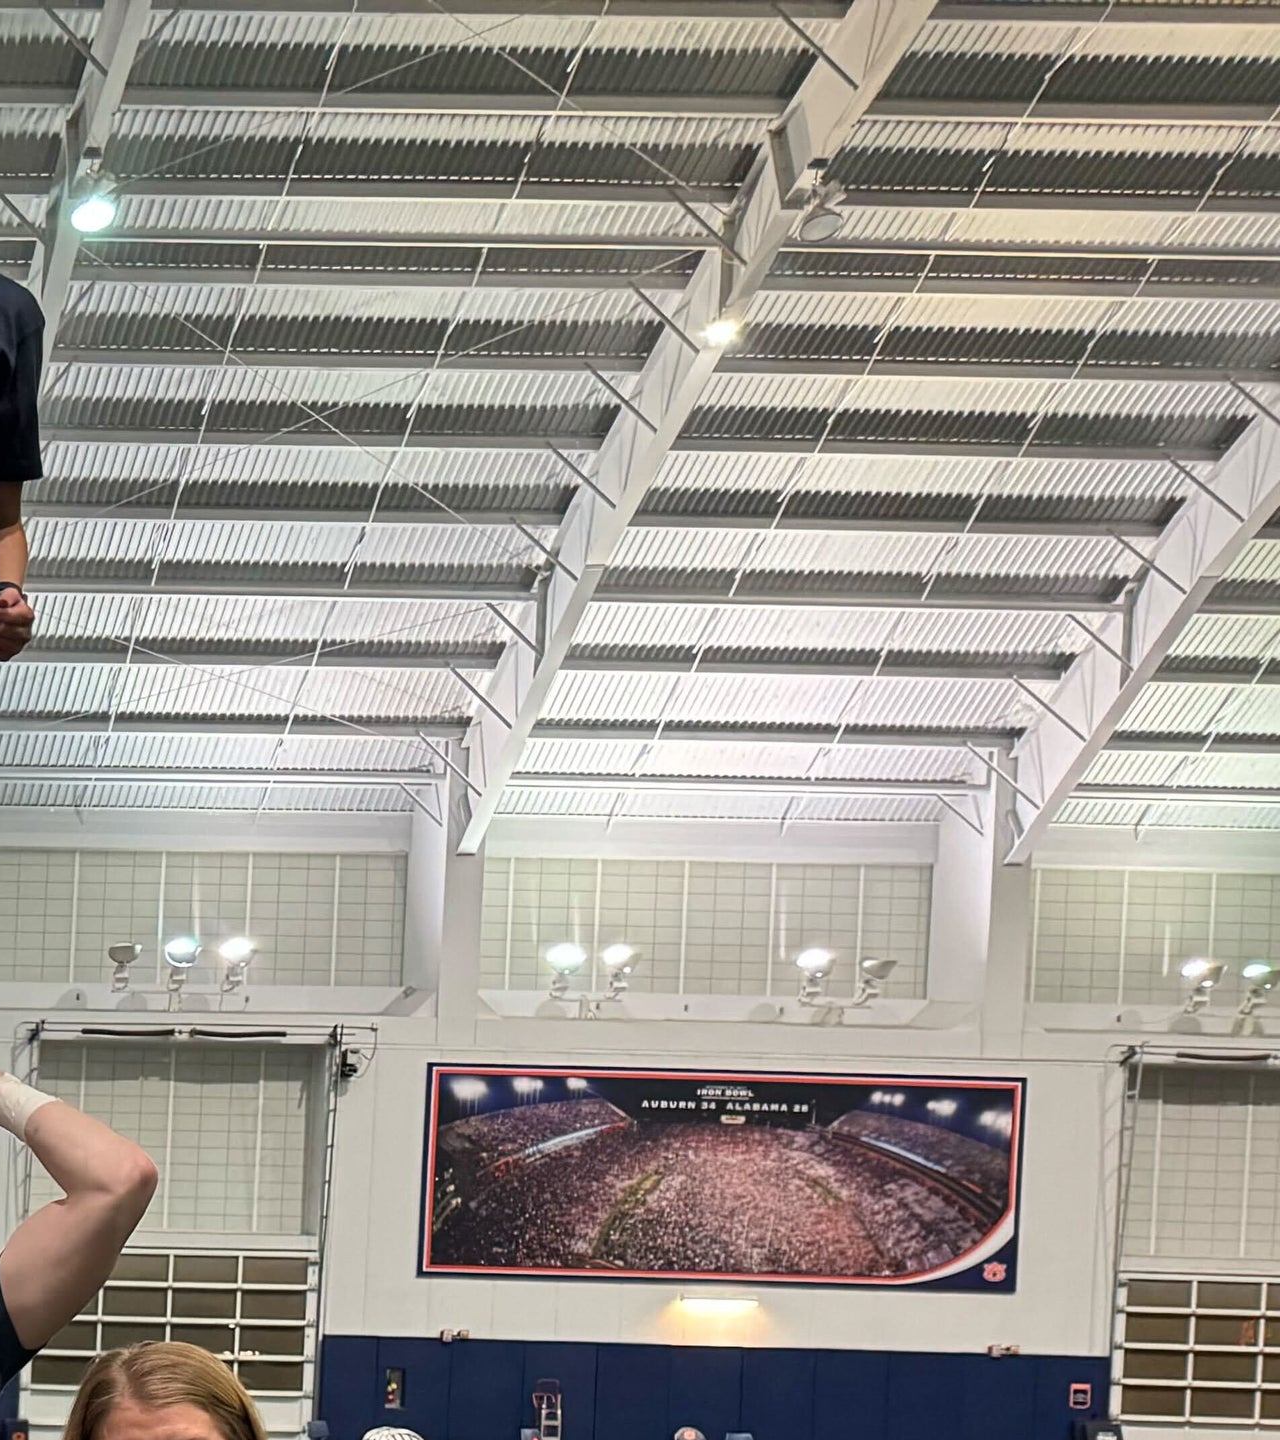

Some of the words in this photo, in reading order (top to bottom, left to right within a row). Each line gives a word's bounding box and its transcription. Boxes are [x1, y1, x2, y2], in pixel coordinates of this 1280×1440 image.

[697, 1088, 722, 1096] IRON
[642, 1100, 696, 1109] AUBURN
[726, 1102, 788, 1112] ALABAMA
